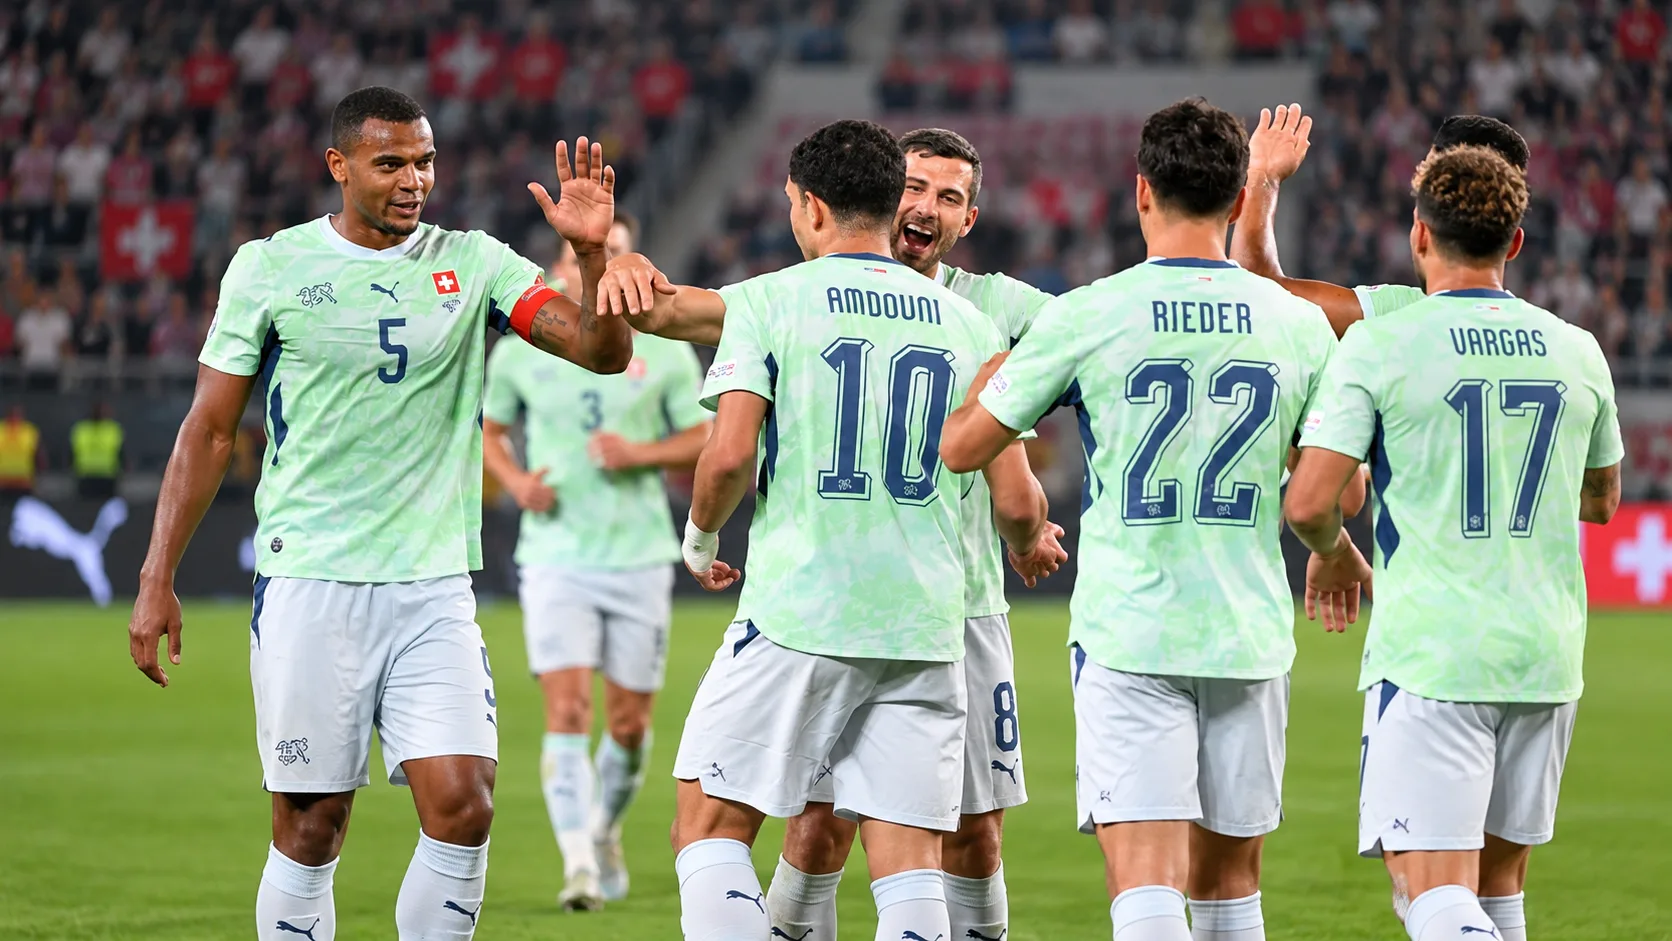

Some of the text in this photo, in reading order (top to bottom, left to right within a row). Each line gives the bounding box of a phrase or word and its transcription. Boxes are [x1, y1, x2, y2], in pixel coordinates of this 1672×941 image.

[827, 287, 941, 325] AMDOUNI
[1152, 301, 1252, 334] RIEDER
[378, 318, 408, 384] 5
[1449, 328, 1547, 357] VARGAS
[581, 390, 603, 432] 3
[817, 337, 956, 507] 10
[1122, 358, 1281, 527] 22
[1444, 379, 1568, 539] 17
[993, 681, 1018, 752] 8
